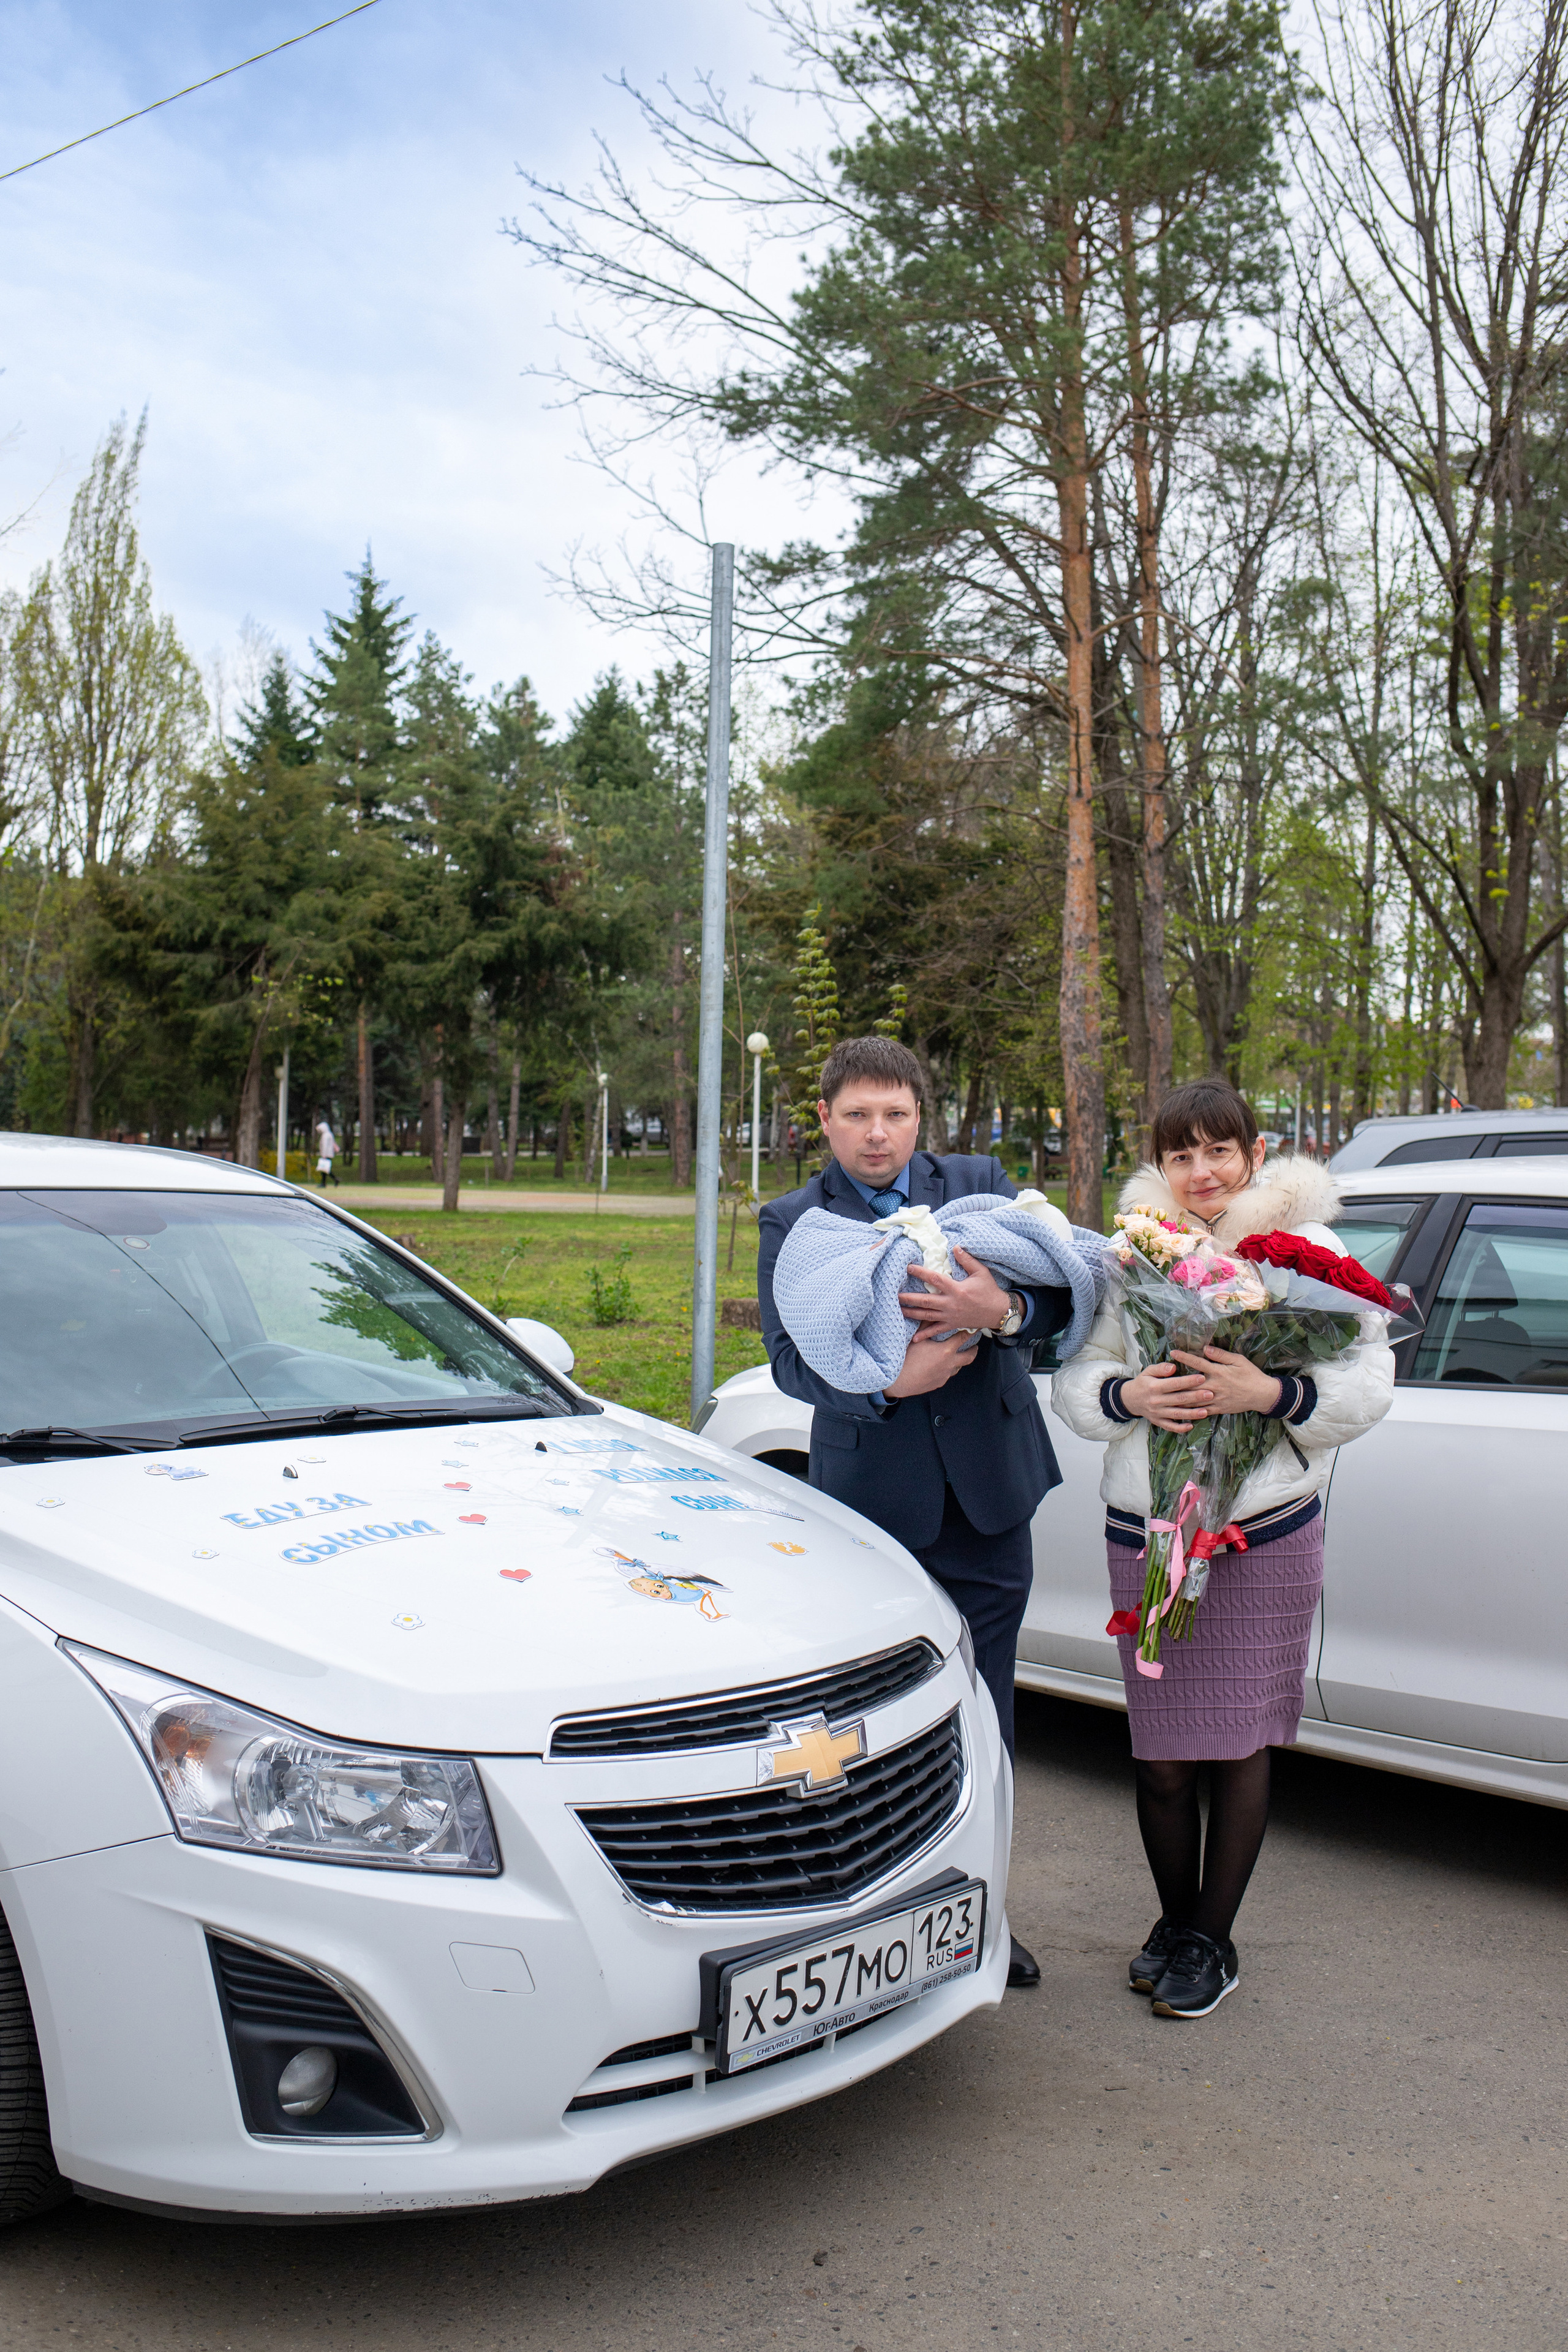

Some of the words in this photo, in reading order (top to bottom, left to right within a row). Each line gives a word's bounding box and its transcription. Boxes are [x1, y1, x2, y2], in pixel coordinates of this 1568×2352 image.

[560, 1439, 645, 1451] МЕНЯ
[590, 1468, 727, 1482] РОДИЛСЯ
[222, 1501, 305, 1528] ЕДУ
[306, 1493, 370, 1511] ЗА
[281, 1519, 442, 1563] СЫНОМ
[918, 1897, 972, 1954] 123
[926, 1948, 953, 1970] RUS
[869, 1991, 909, 2013] Краснодар
[921, 1978, 938, 1994] (861)
[939, 1964, 971, 1984] 258-50-50
[756, 2034, 801, 2056] CHEVROLET
